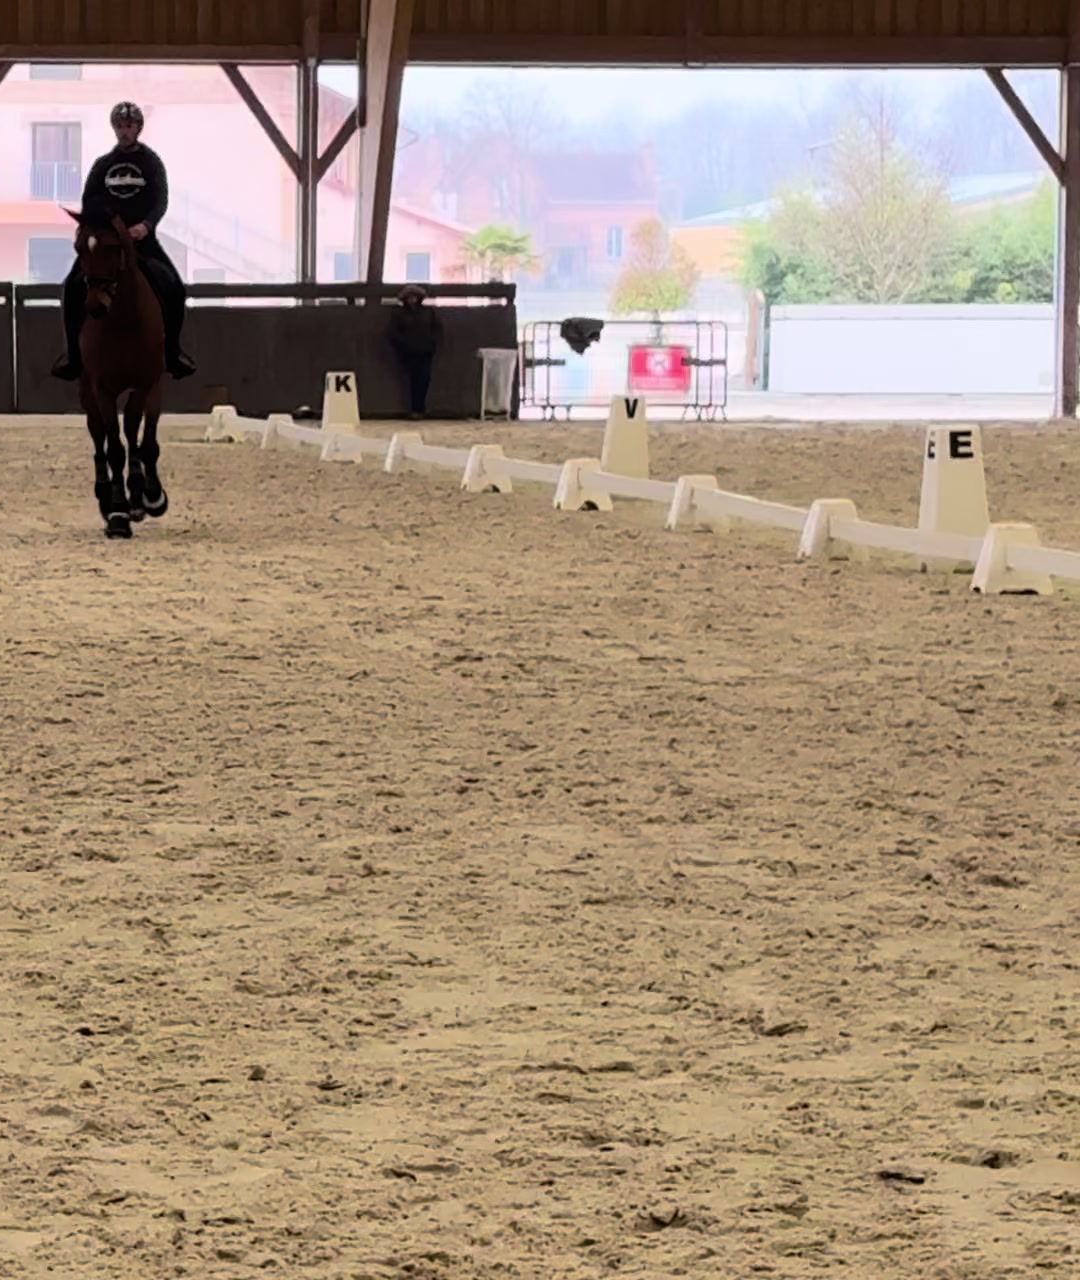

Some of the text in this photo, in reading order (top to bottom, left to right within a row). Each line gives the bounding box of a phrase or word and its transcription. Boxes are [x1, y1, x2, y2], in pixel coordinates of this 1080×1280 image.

[335, 375, 352, 392] K
[625, 398, 638, 419] V
[949, 431, 974, 459] E
